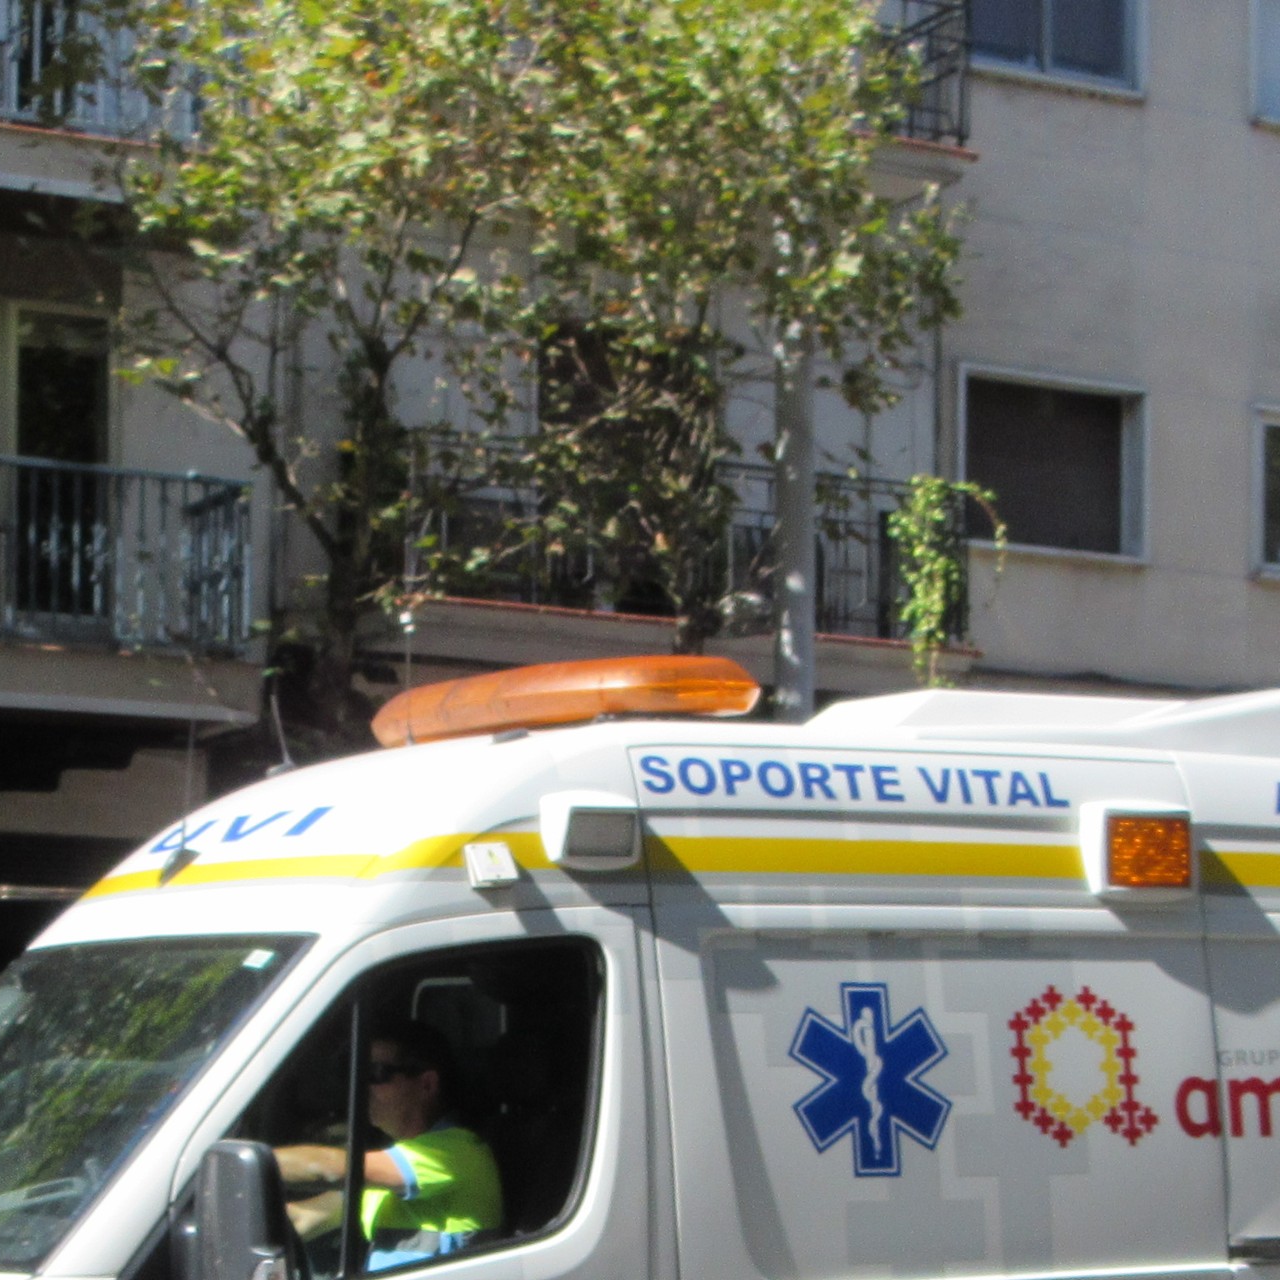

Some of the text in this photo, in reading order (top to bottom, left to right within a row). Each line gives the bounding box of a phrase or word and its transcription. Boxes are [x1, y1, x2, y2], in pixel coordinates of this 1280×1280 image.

[639, 754, 1071, 808] SOPORTE VITAL
[148, 806, 336, 855] UVI
